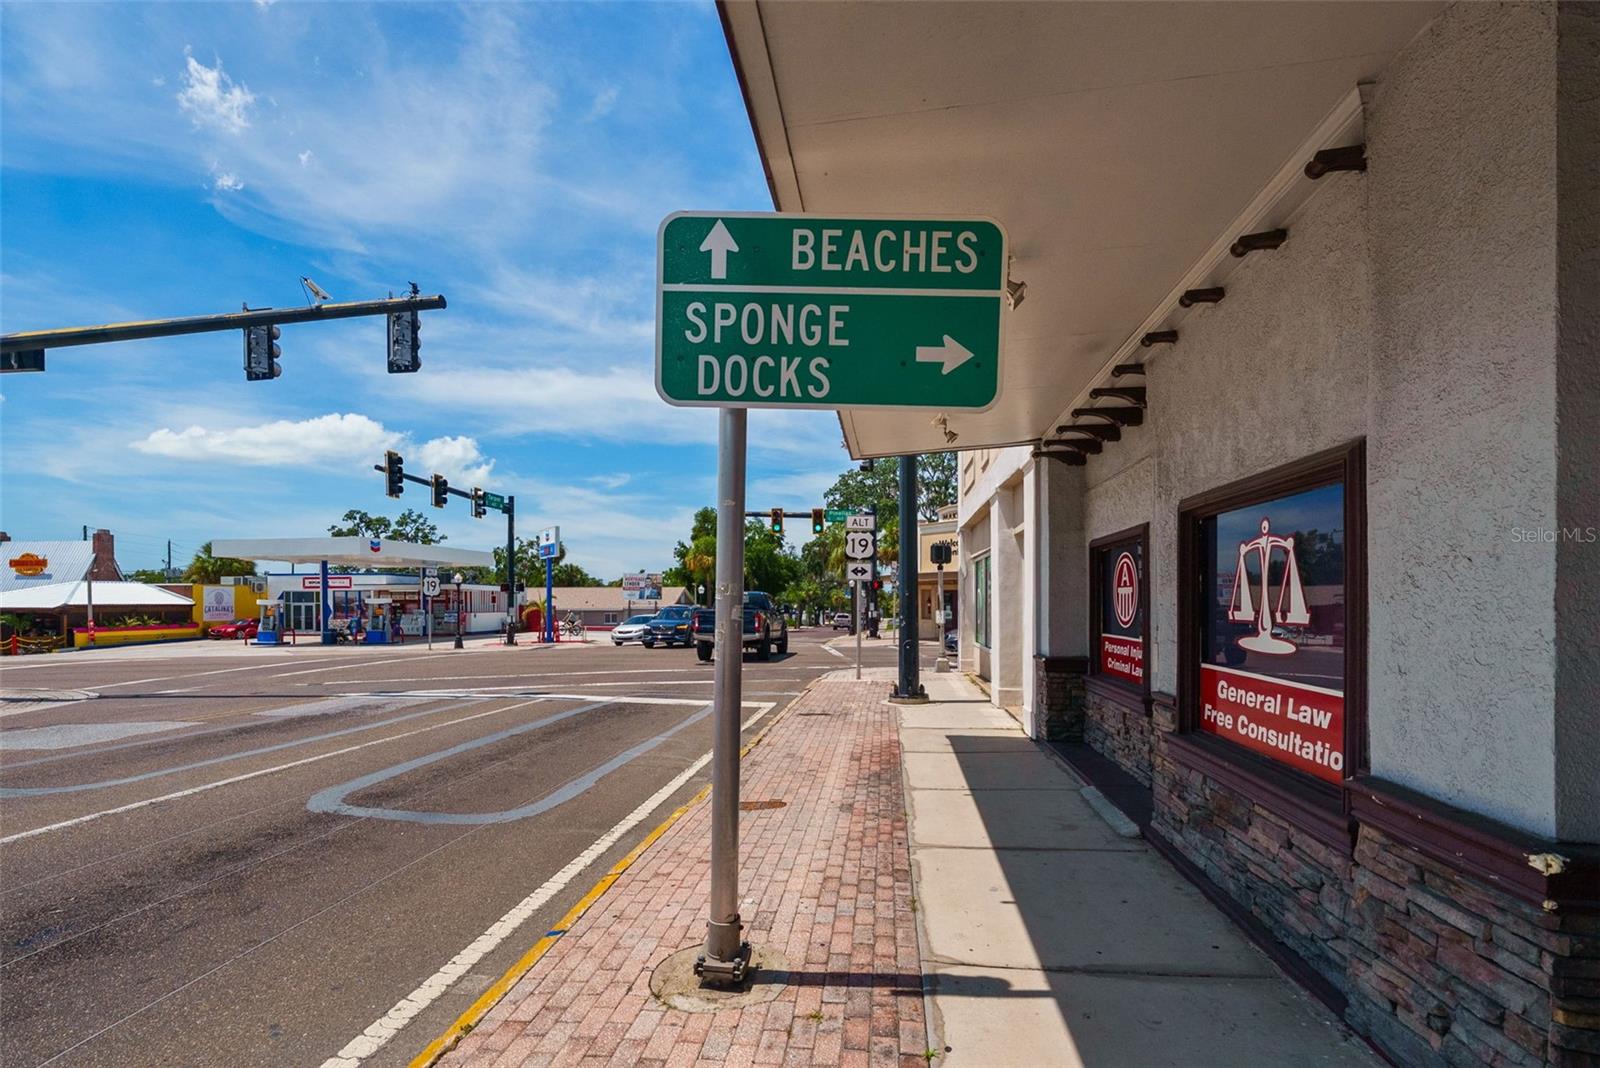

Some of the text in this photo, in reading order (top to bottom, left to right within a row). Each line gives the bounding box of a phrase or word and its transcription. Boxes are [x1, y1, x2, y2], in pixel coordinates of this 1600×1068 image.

[791, 228, 979, 274] BEACHES
[684, 301, 850, 346] SPONGE
[697, 354, 831, 398] DOCKS
[851, 518, 869, 527] ALT
[851, 537, 869, 553] 19
[426, 580, 437, 592] 19
[1120, 563, 1130, 586] A
[1104, 641, 1130, 656] Personal
[1107, 657, 1131, 673] Criminal
[1217, 680, 1333, 730] General Law
[1204, 703, 1344, 771] Free Consultatio
